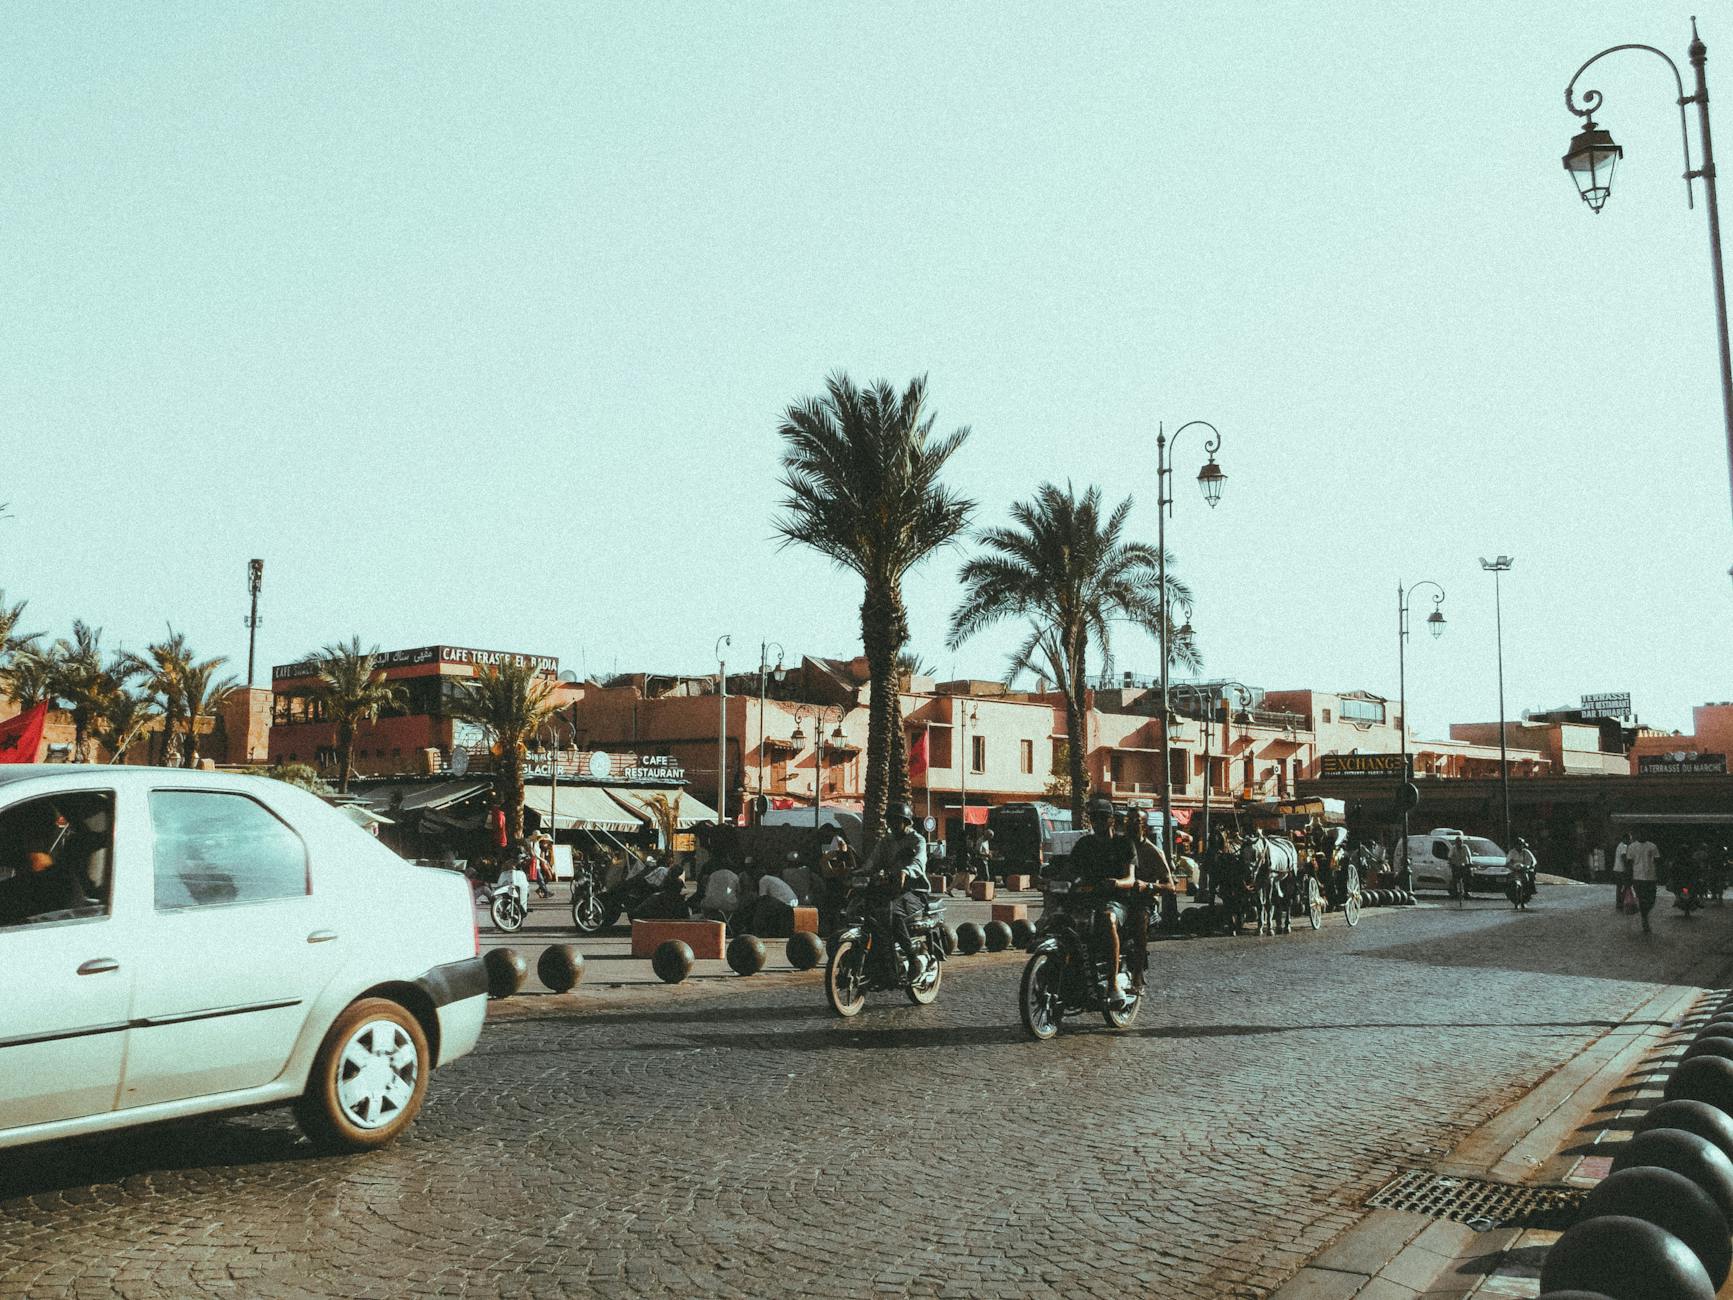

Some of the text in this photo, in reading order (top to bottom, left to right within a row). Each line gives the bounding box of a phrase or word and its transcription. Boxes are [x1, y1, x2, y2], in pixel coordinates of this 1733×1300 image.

[443, 648, 468, 662] CAFE
[1582, 692, 1630, 702] TERRASSE
[642, 755, 668, 765] CAFE
[624, 767, 685, 778] RESTAURANT
